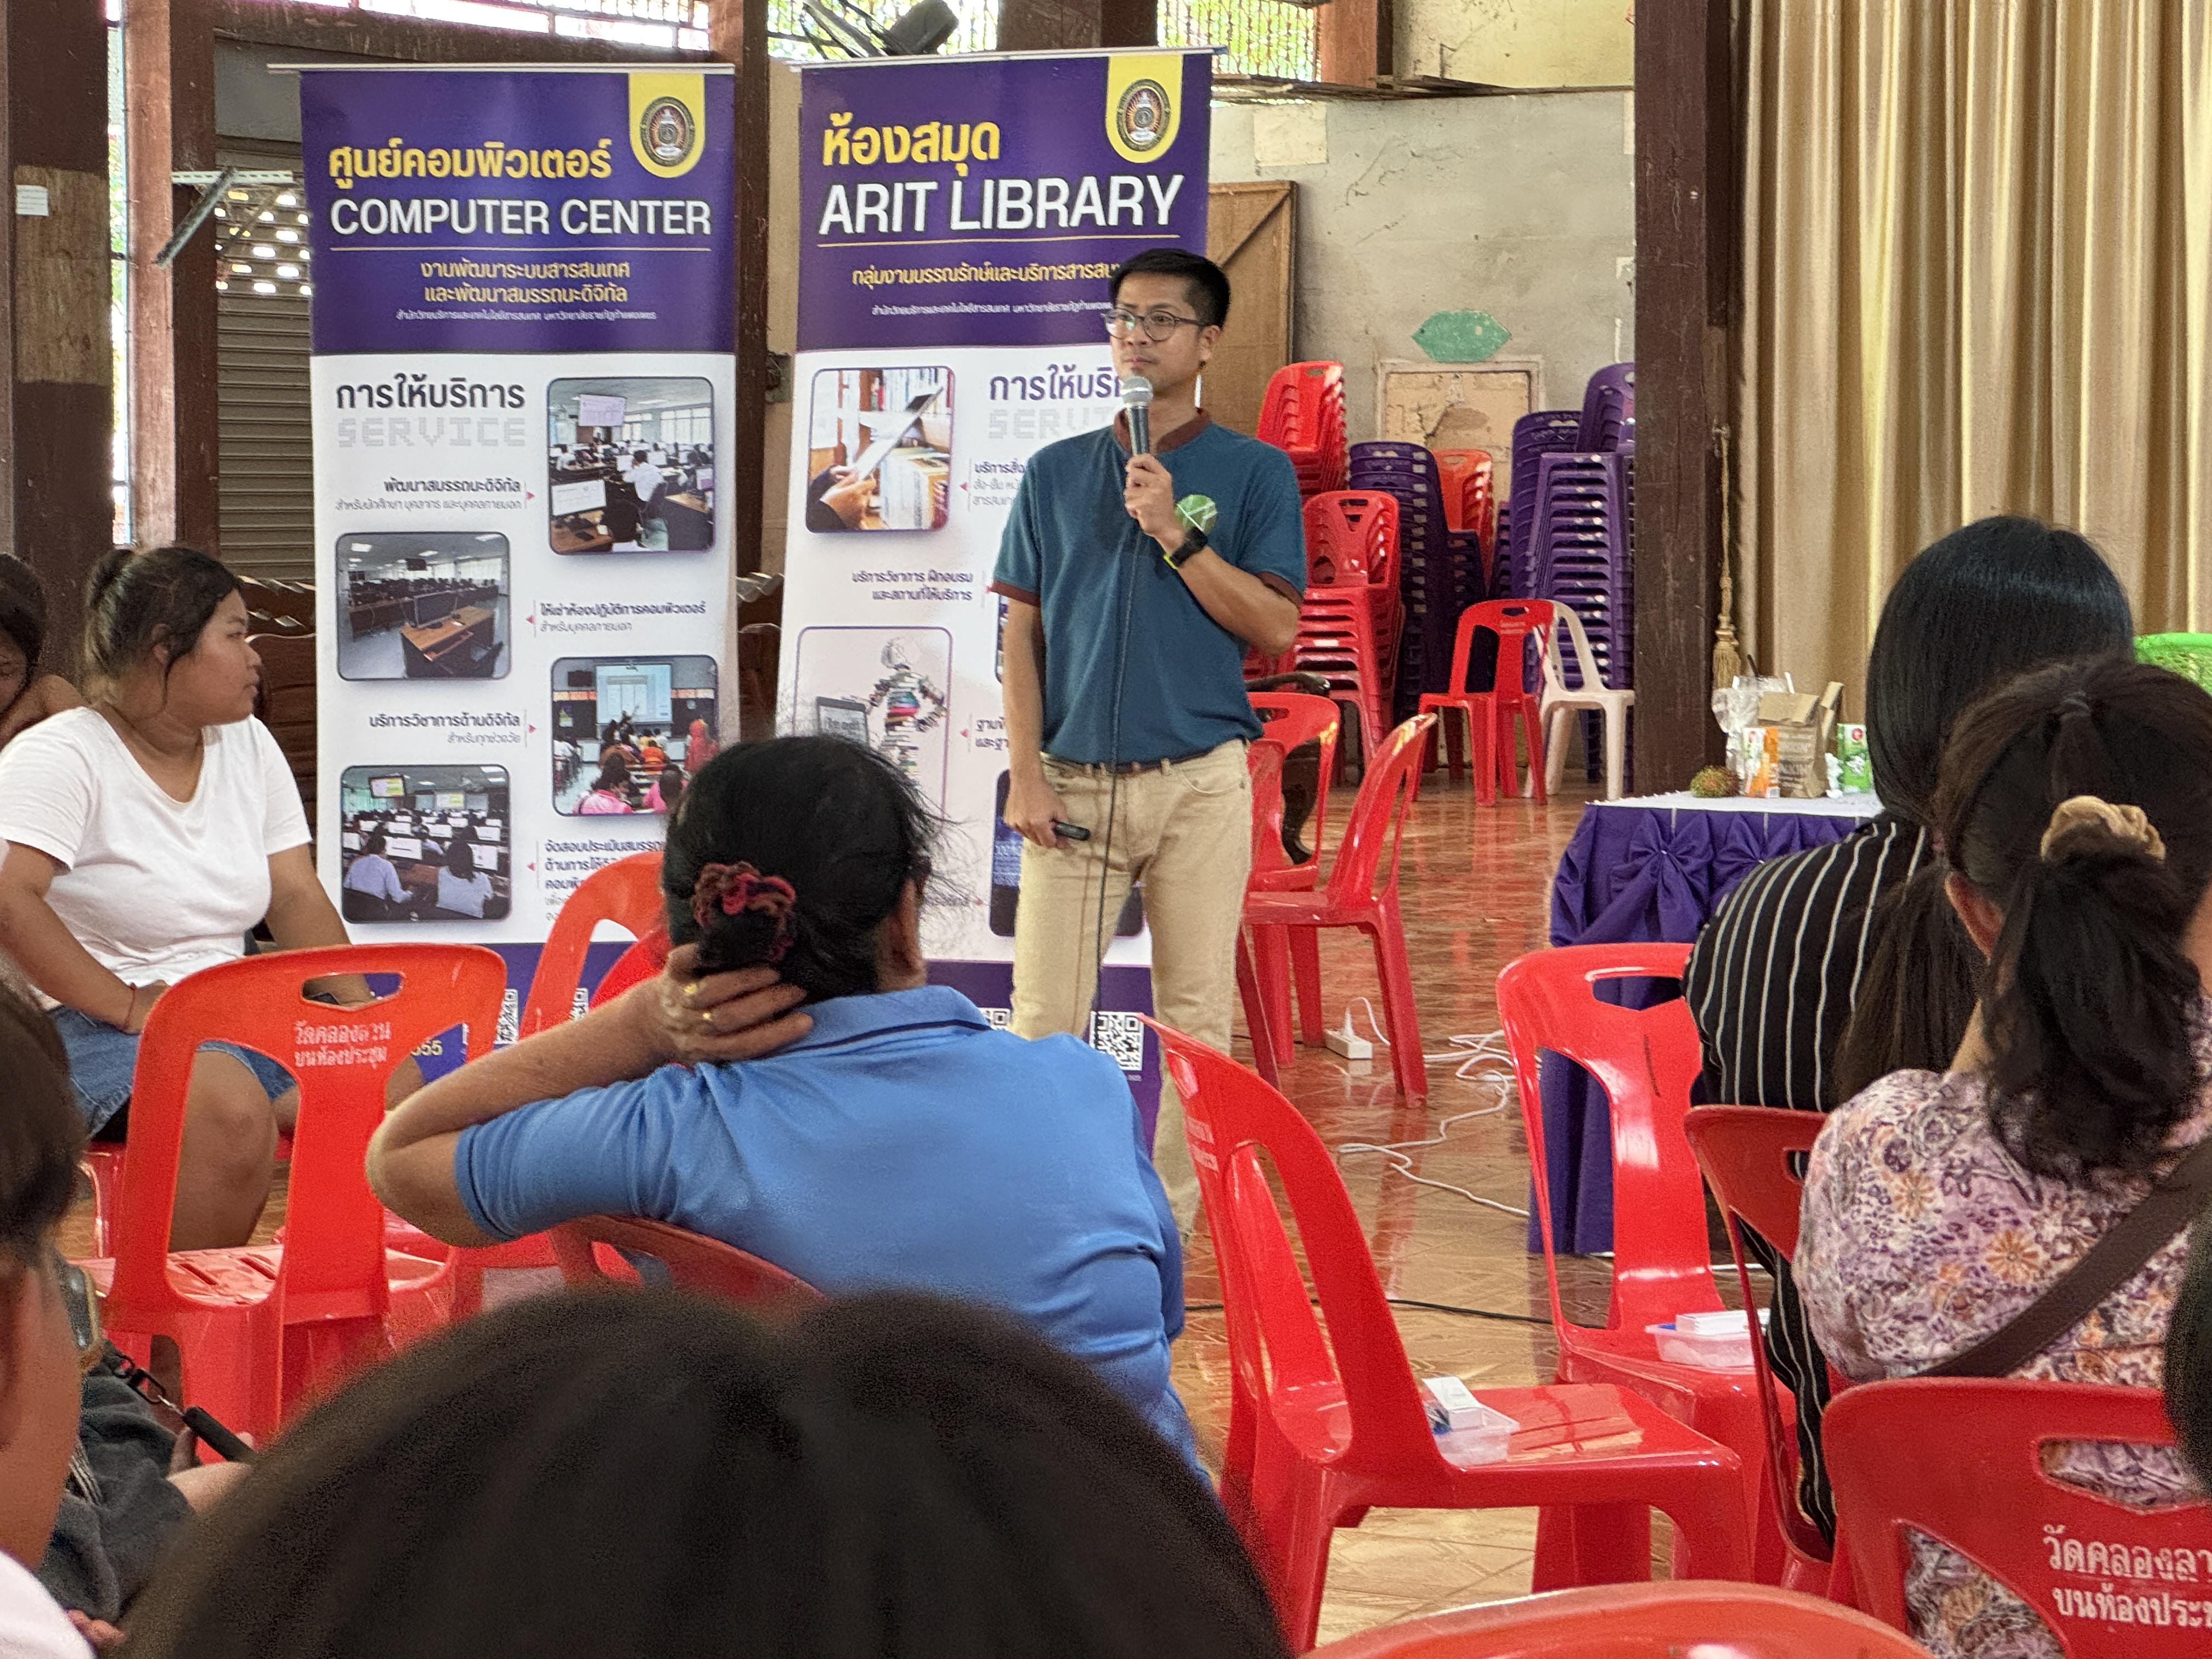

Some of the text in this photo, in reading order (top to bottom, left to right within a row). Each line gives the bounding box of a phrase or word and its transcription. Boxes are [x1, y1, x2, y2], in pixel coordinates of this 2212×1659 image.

[823, 112, 1000, 176] ห้องสมุด
[329, 137, 613, 189] ศูนย์คอมพิวเตอร์
[331, 199, 711, 235] COMPUTER CENTER
[819, 174, 1184, 235] ARIT LIBRARY
[421, 257, 630, 278] งานพัฒนาระบบสารสนเทศ
[852, 262, 1120, 290] กลุ่มงานบรรณรักษ์และบริการสารสน
[424, 281, 628, 303] และพัฒนาสมรรถนะดิจิทัล
[336, 373, 525, 409] การให้บริการ
[338, 417, 525, 447] SERVICE
